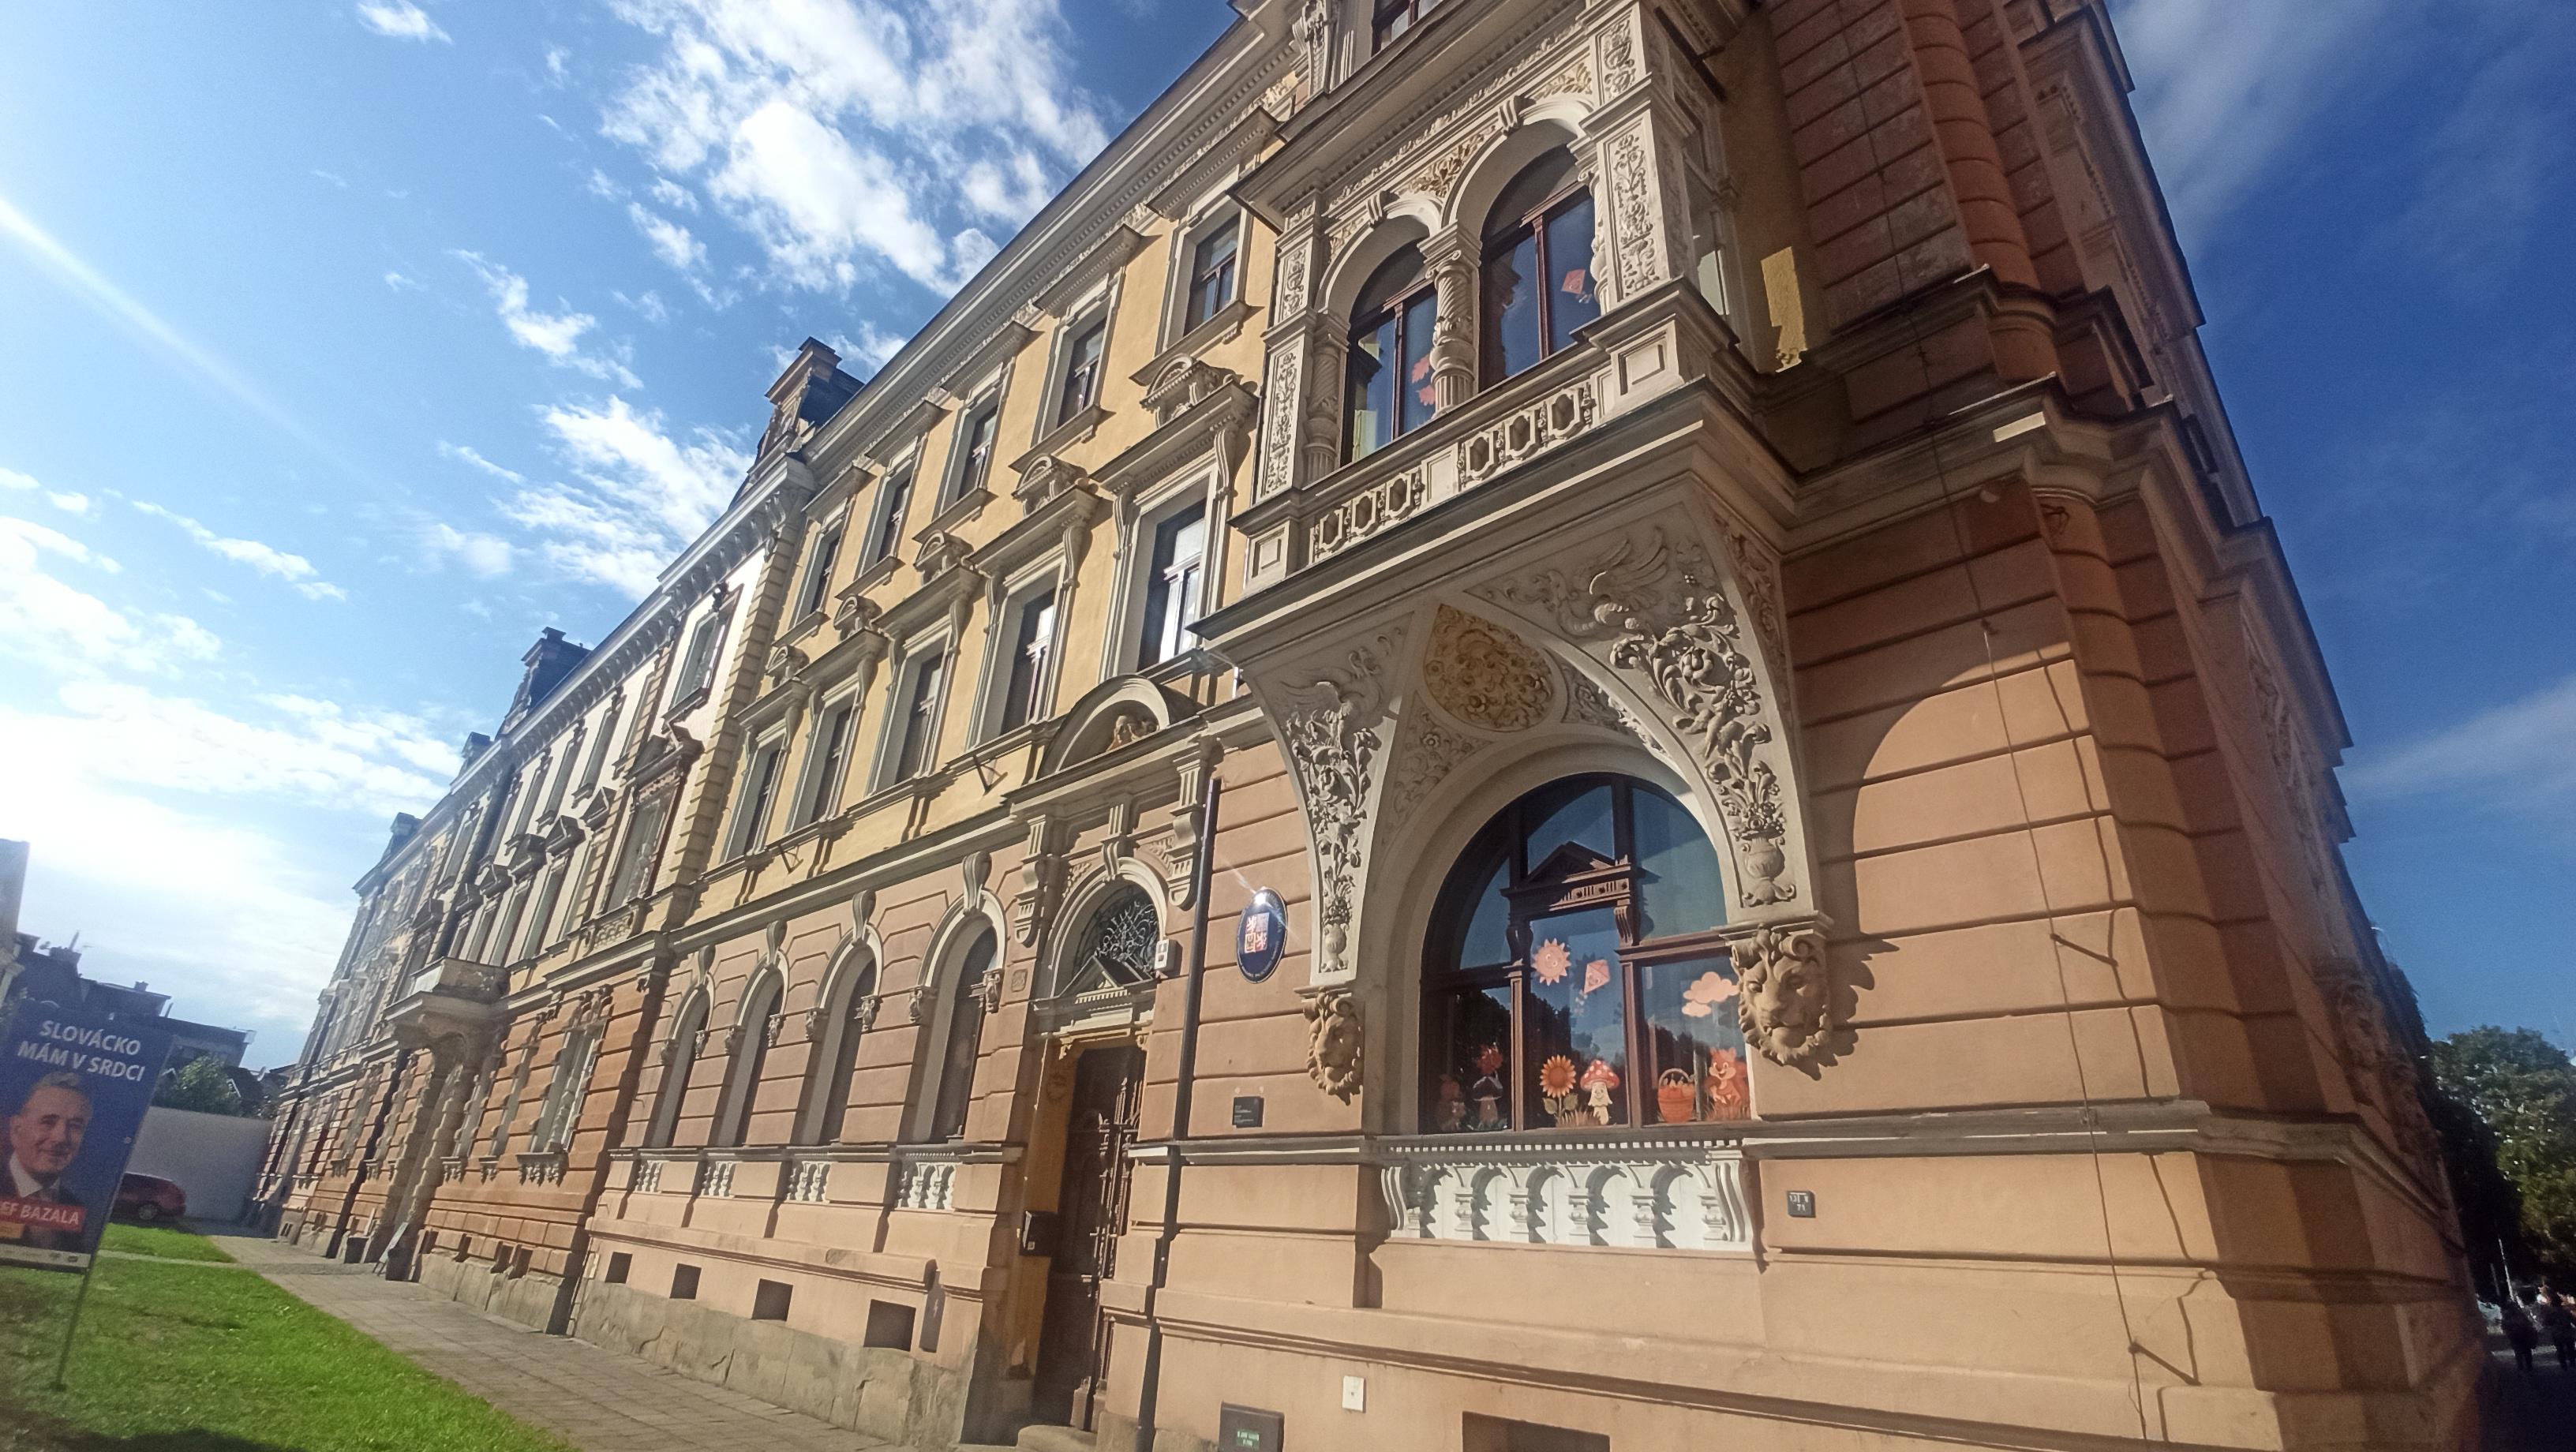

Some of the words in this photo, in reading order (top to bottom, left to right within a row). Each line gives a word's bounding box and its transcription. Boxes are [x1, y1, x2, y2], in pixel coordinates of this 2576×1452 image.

[40, 1020, 141, 1055] SLOVÁCKO
[17, 1040, 69, 1066] MÁM
[73, 1053, 87, 1068] V
[87, 1057, 145, 1082] SRDCI
[20, 1204, 79, 1226] BAZALA
